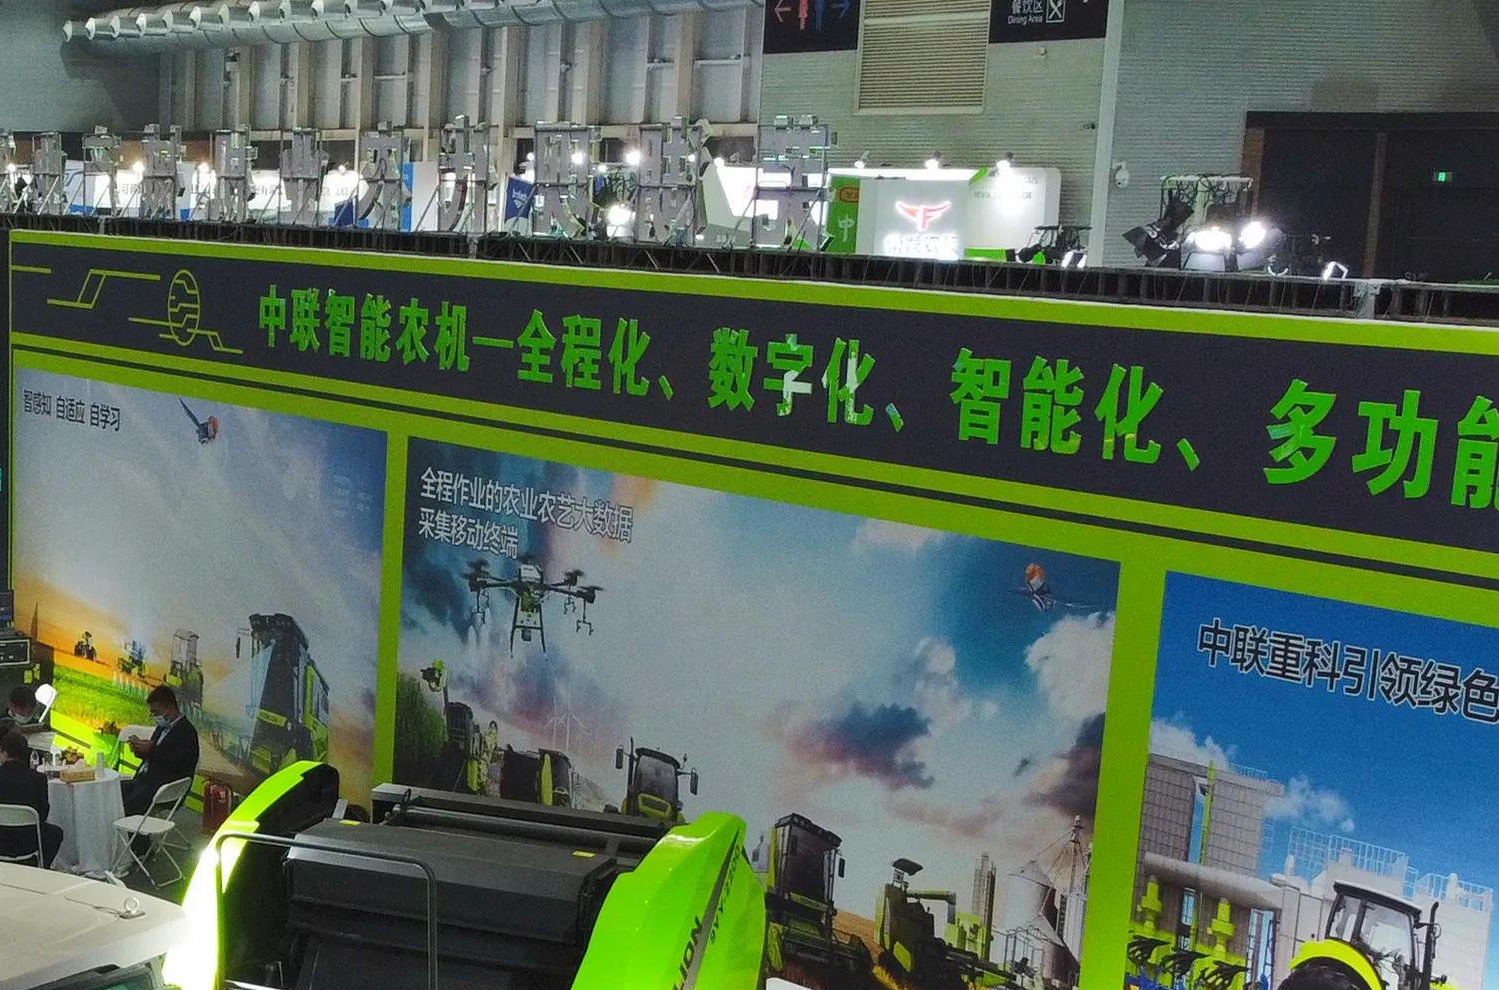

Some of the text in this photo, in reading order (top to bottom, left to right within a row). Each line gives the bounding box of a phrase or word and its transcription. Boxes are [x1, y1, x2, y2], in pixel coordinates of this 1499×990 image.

[23, 389, 120, 432] 智感知 自适应 自学习
[418, 506, 519, 560] 采集移动终端
[420, 466, 634, 543] 全程作业的农业农艺大数据
[1197, 617, 1499, 725] 中联重科引领绿色
